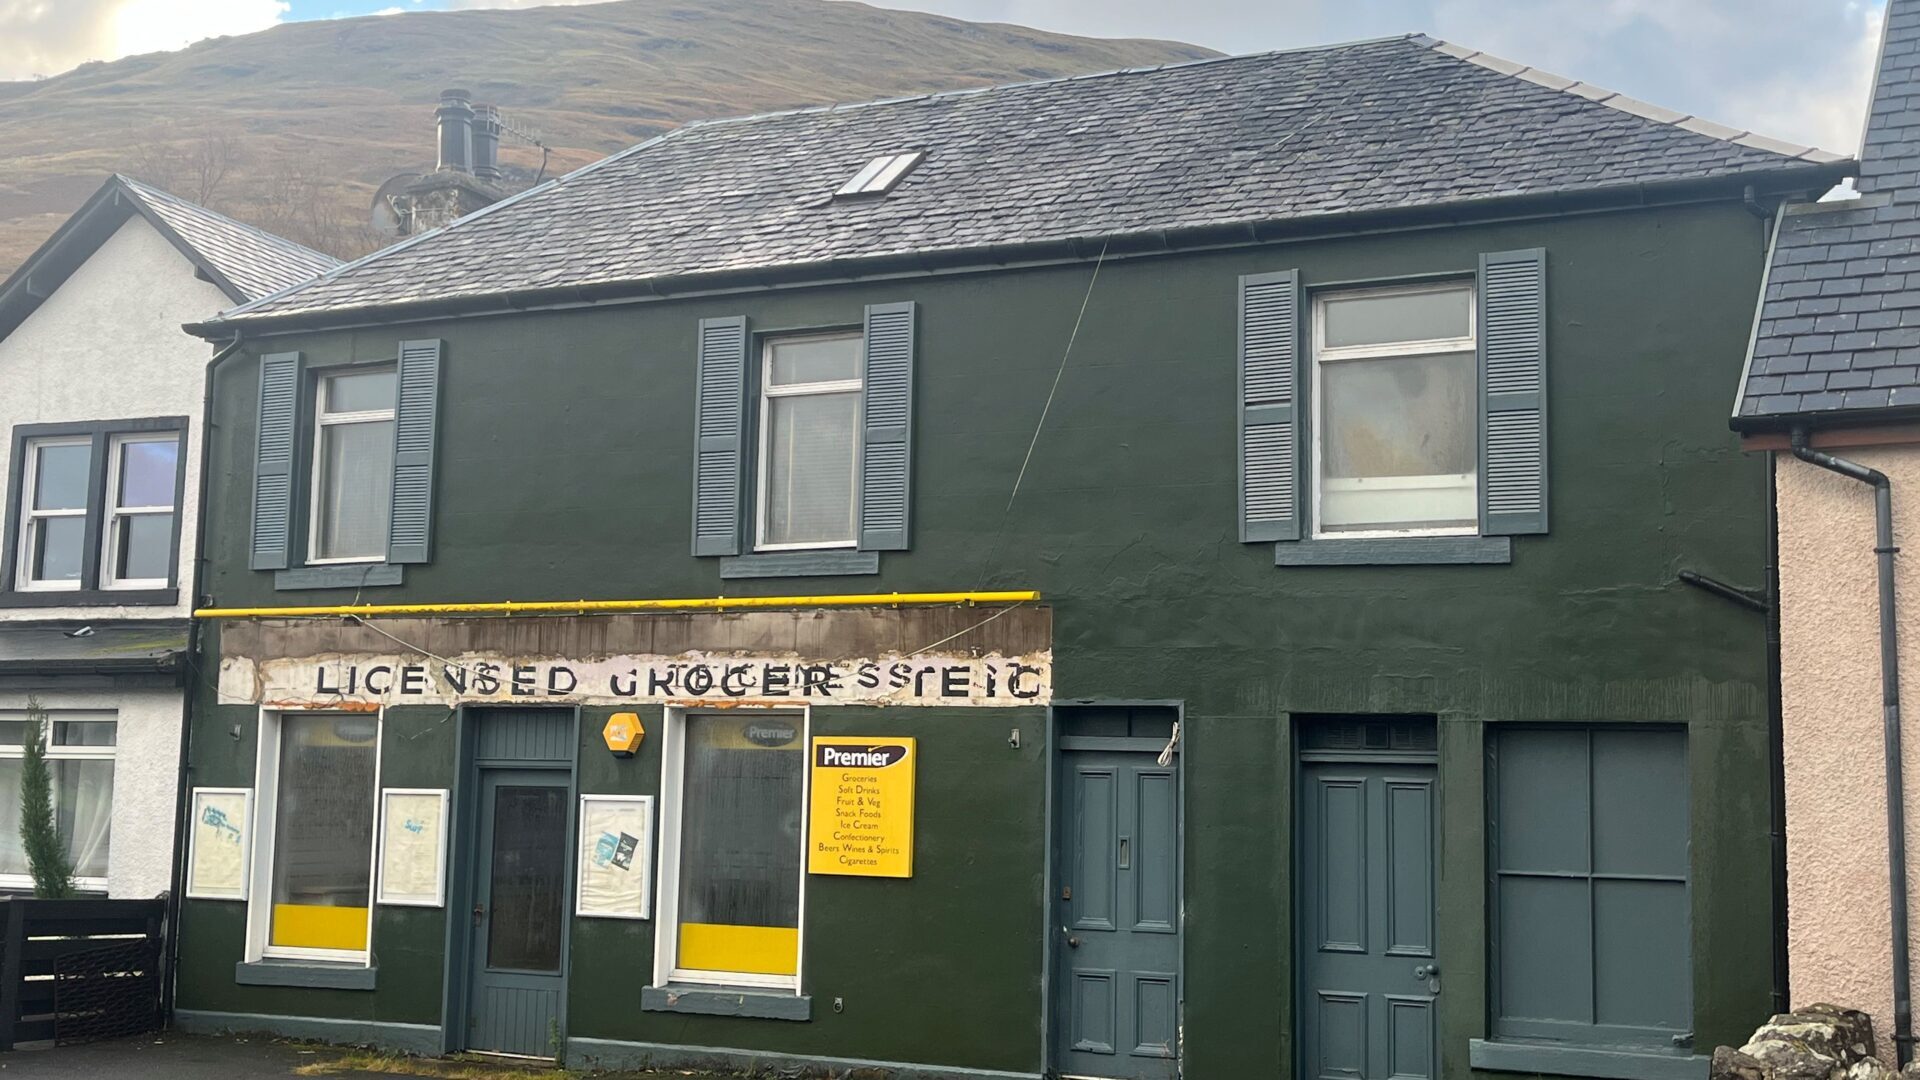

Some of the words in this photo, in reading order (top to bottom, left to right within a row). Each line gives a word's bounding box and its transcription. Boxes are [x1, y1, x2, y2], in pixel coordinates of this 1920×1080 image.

[317, 662, 578, 696] LICENSED
[750, 726, 795, 739] Premier
[823, 747, 890, 766] Premier
[842, 773, 877, 783] Groceries
[838, 785, 854, 794] Soft
[855, 785, 880, 795] Drinks
[836, 796, 854, 806] Fruit
[857, 796, 864, 806] &
[867, 797, 881, 808] Veg
[835, 808, 856, 817] Snack
[859, 808, 881, 818] Foods
[840, 820, 851, 829] Ice
[853, 820, 878, 830] Cream
[833, 831, 885, 843] Confectionery
[818, 842, 839, 852] Beers
[842, 843, 865, 853] Wines
[876, 845, 900, 855] Spirits
[839, 855, 878, 866] Cigarettes
